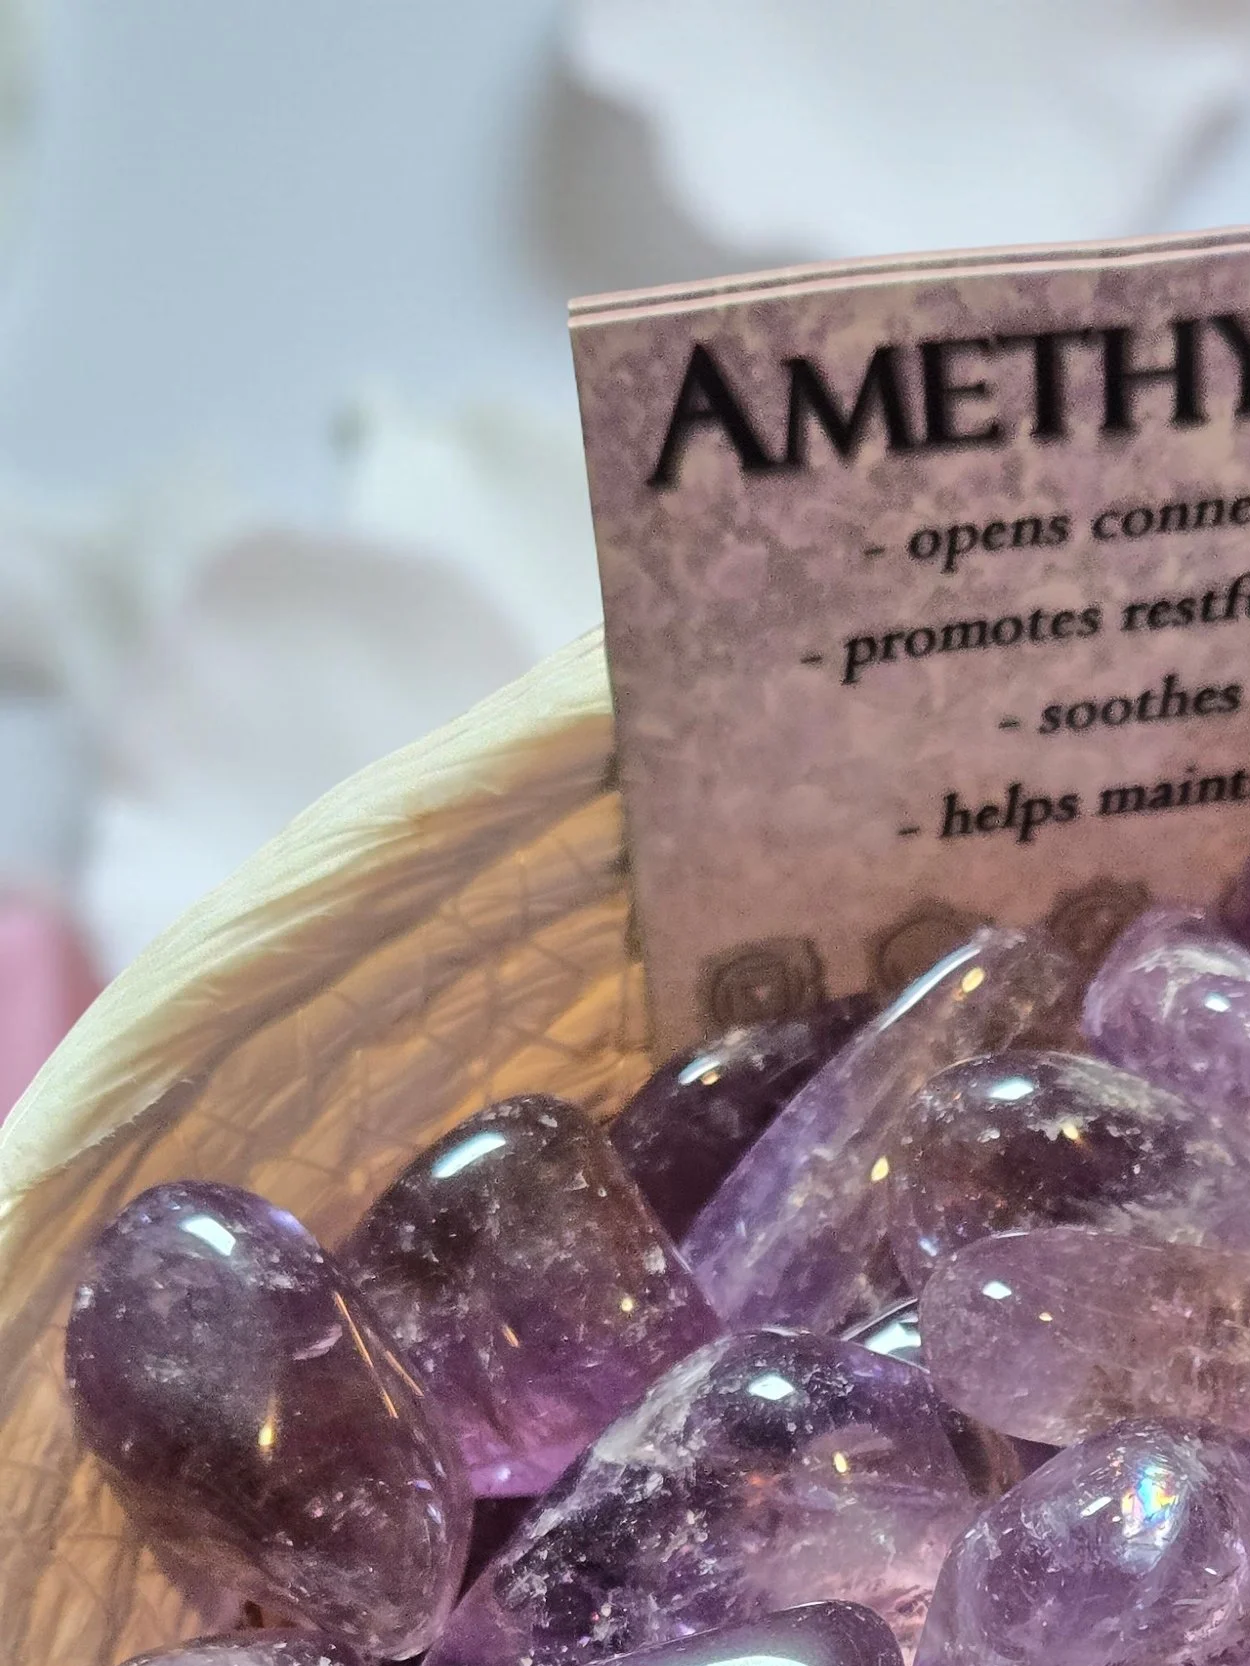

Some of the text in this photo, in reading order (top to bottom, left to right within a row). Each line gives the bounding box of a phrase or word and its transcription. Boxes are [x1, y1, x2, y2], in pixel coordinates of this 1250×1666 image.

[906, 508, 1069, 573] opens
[842, 605, 1103, 686] promotes
[1038, 672, 1240, 736] soothes
[940, 782, 1080, 846] helps
